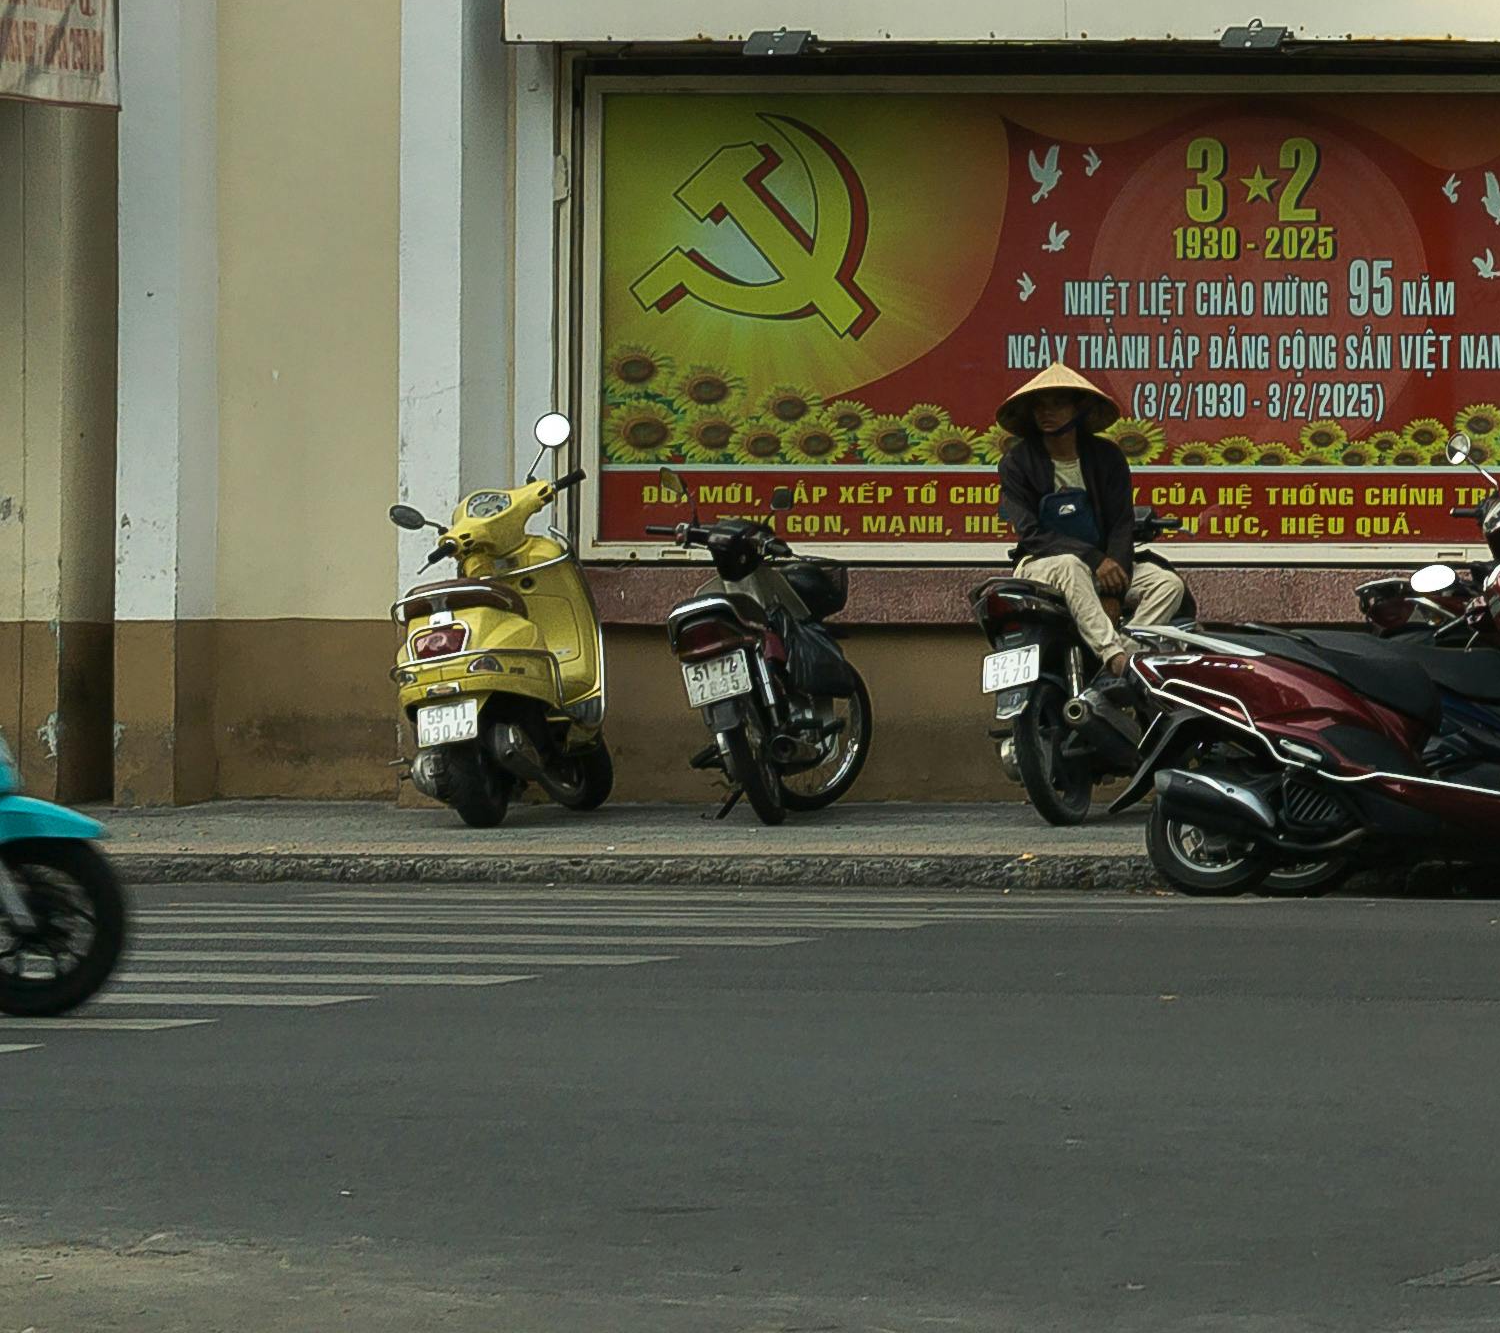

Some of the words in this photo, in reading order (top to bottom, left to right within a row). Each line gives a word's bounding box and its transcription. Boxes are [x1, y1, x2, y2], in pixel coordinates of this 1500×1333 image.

[1186, 137, 1225, 222] 3
[1278, 137, 1318, 222] 2
[1172, 226, 1238, 260] 1930
[1264, 226, 1334, 260] 2025
[1064, 275, 1130, 323] NHIỆT
[1138, 275, 1187, 323] LIỆT
[1195, 274, 1255, 316] CHÀO
[1263, 275, 1329, 316] MỪNG
[1349, 259, 1393, 317] 95
[1402, 275, 1455, 316] NĂM
[1007, 328, 1068, 369] NGÀY
[1077, 328, 1150, 370] THÀNH
[1158, 329, 1200, 377] LẬP
[1208, 325, 1270, 370] ĐẢNG
[1278, 329, 1337, 377] CỘNG
[1345, 325, 1392, 370] SẢN
[1400, 329, 1452, 377] VIỆT
[1133, 382, 1246, 421] (3/2/1930
[1268, 382, 1386, 422] 3/2/2025)
[838, 482, 893, 504] XẾP
[904, 480, 938, 504] TỔ
[1151, 482, 1207, 506] CỦA
[1218, 484, 1253, 509] HỆ
[1266, 481, 1354, 506] THỐNG
[1364, 483, 1443, 506] CHÍNH
[786, 514, 849, 537] GỌN,
[862, 515, 953, 537] MẠNH,
[965, 514, 1016, 537] HIỆ
[1209, 515, 1269, 538] LỰC,
[1281, 515, 1345, 538] HIỆU
[1355, 511, 1421, 536] QUẢ.
